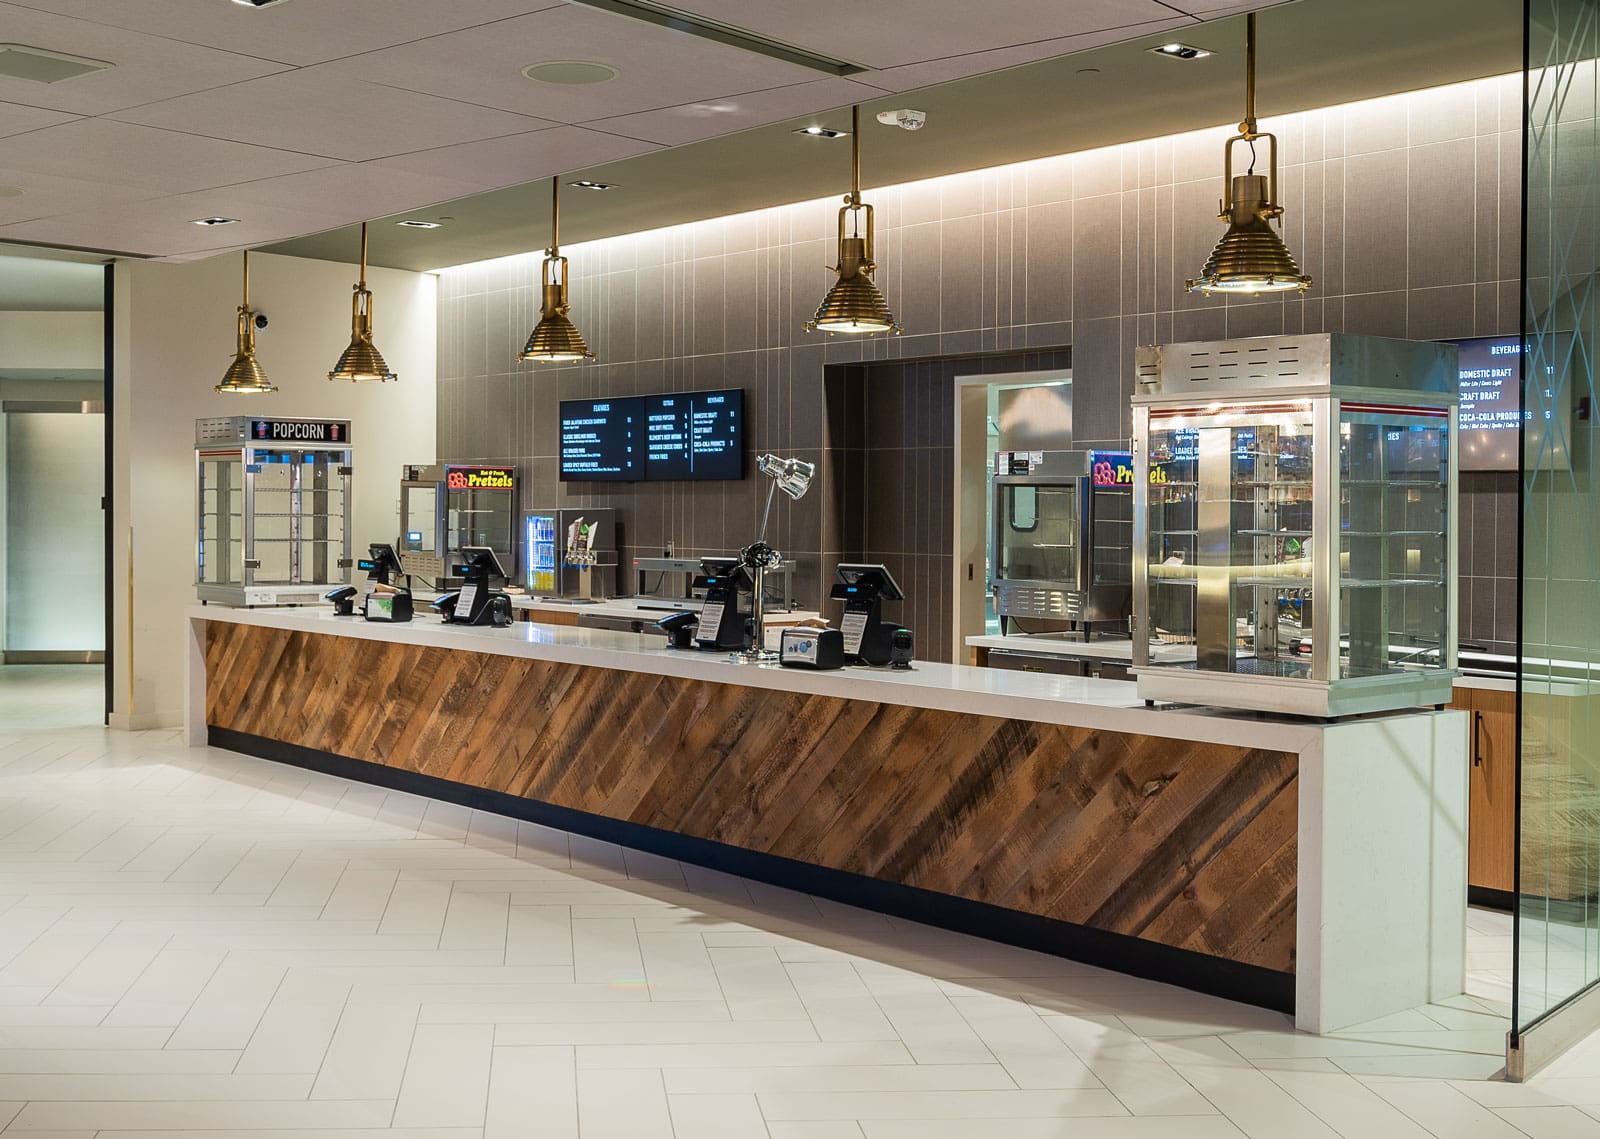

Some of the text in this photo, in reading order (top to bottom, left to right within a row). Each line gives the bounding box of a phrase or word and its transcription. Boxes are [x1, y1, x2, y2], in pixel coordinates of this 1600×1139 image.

[1459, 368, 1512, 379] DOMESTIC DRAFT
[1480, 391, 1501, 401] DRAFT
[1459, 411, 1496, 422] COCA-COLA
[273, 423, 324, 439] POPCORN
[468, 474, 513, 487] Pretzels
